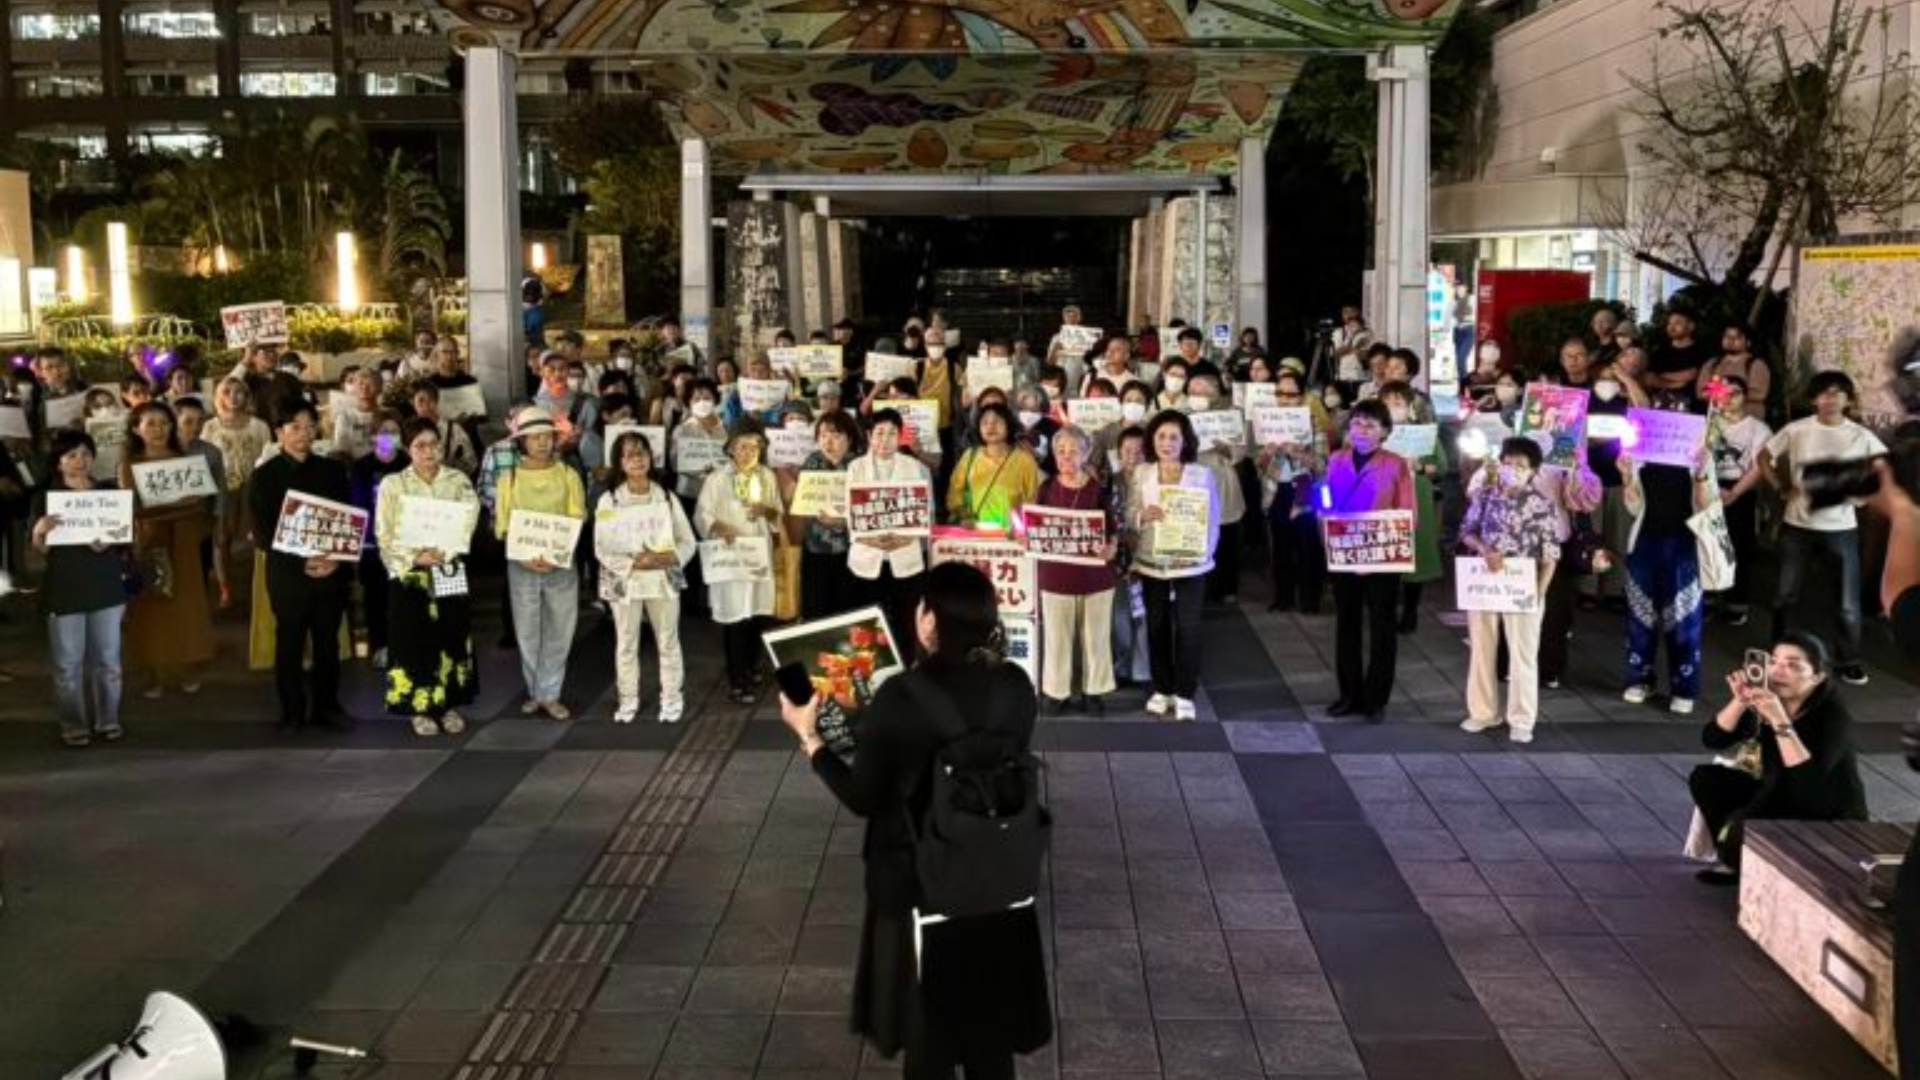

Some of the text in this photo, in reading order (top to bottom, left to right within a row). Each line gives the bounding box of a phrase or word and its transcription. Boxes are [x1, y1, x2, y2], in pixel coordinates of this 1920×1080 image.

[145, 466, 204, 497] 殺すな
[75, 499, 94, 508] Me
[99, 499, 119, 508] Too
[98, 517, 120, 528] You
[1504, 584, 1525, 596] You
